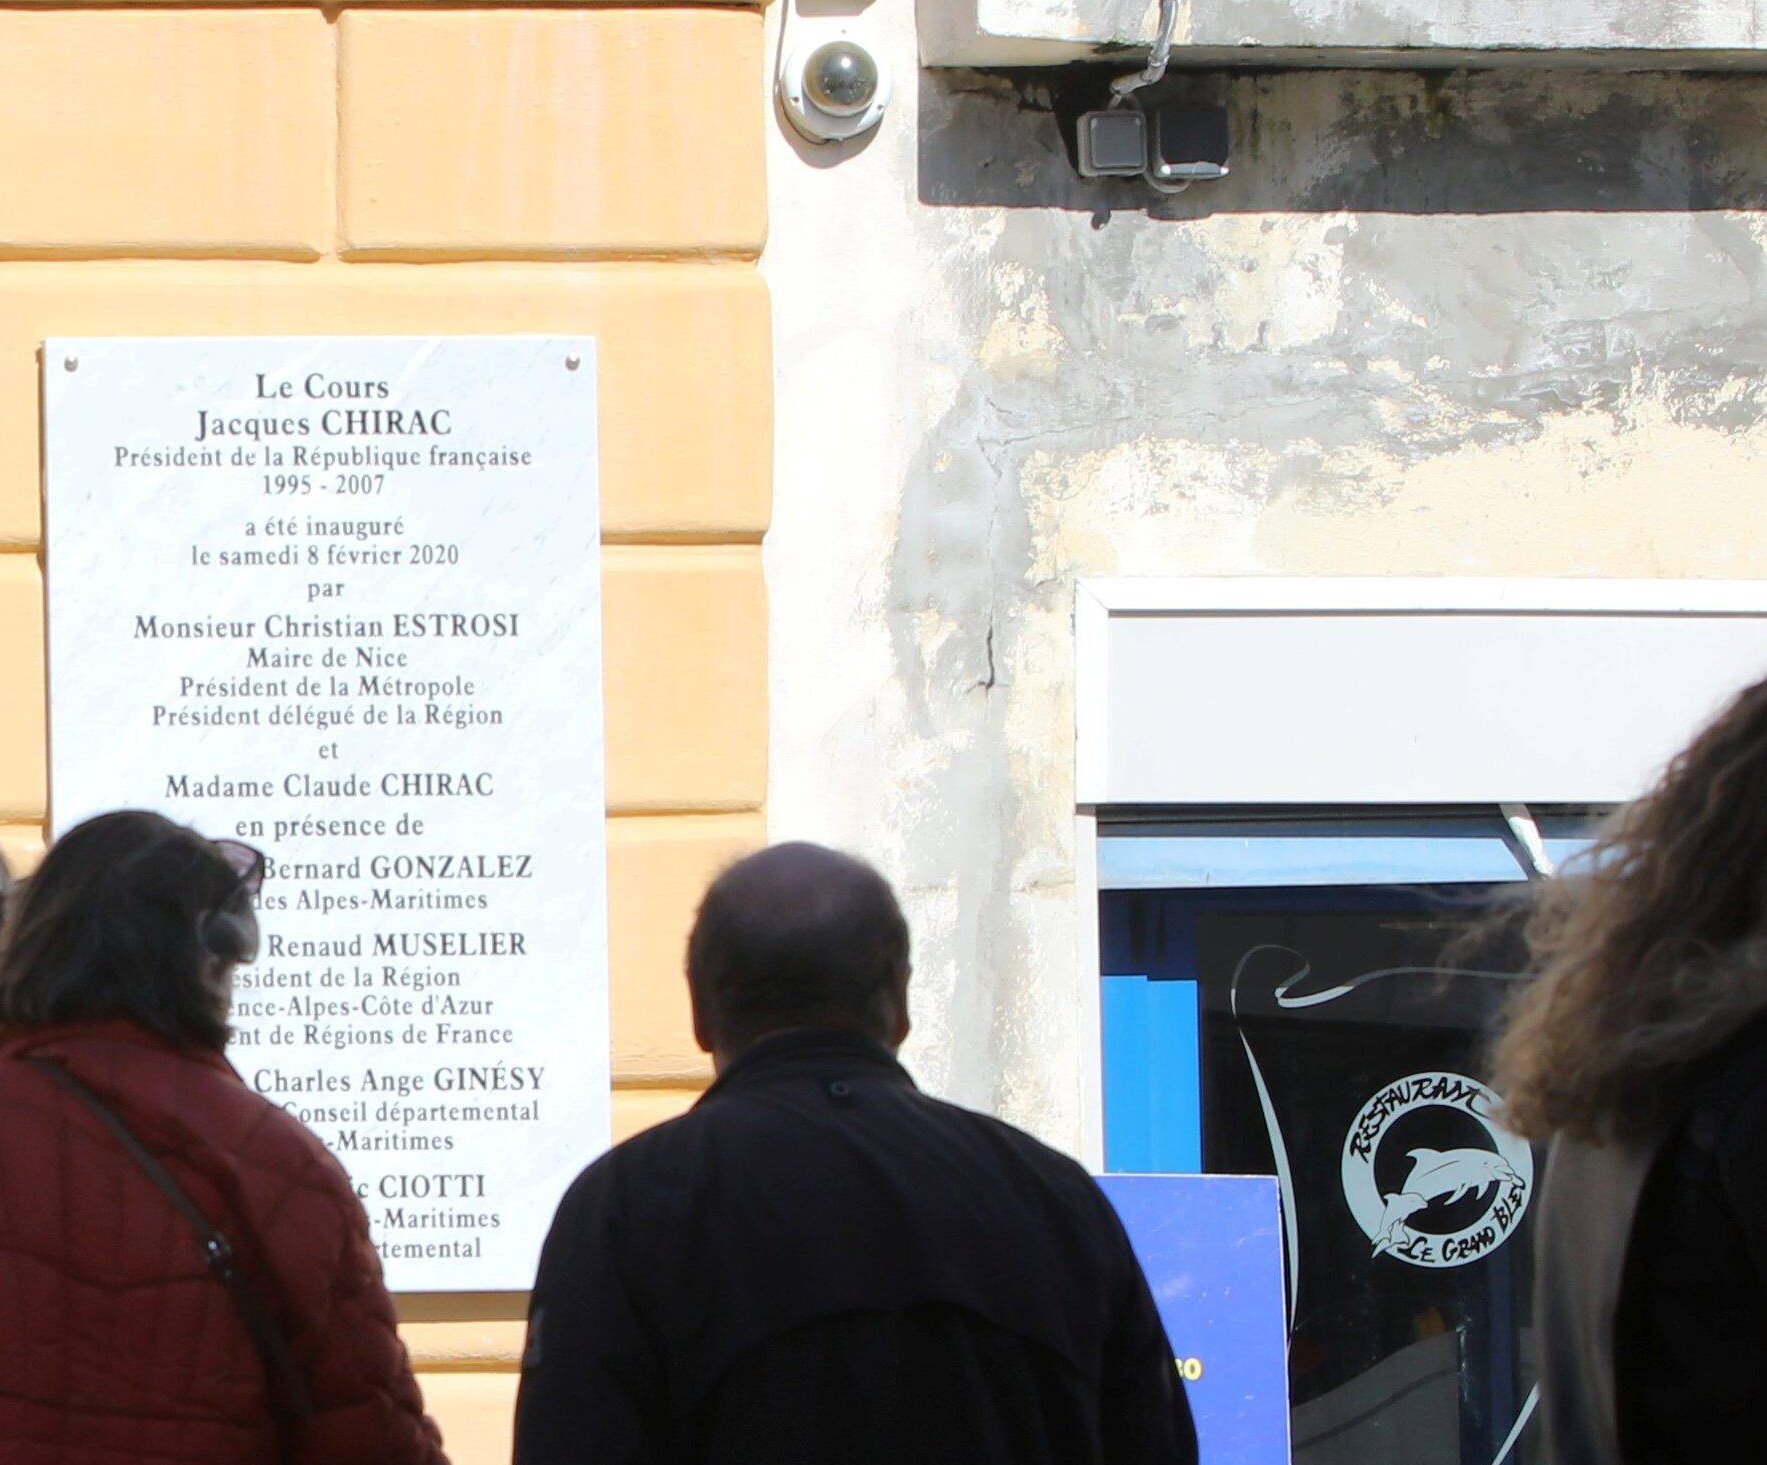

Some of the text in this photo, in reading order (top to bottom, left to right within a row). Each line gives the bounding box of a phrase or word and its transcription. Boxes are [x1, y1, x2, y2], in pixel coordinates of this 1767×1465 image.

[255, 372, 390, 400] Le Cours
[194, 409, 452, 443] Jacques CHIRAC
[114, 444, 532, 472] Président de la République française
[263, 473, 312, 495] 1995
[335, 473, 385, 495] 2007
[244, 515, 404, 541] a été inauguré
[191, 543, 459, 566] le samedi 8 février 2020
[307, 582, 345, 603] par
[133, 613, 518, 639] Monsieur Christian ESTROSI
[246, 646, 408, 669] Maire de Nice
[179, 674, 475, 702] Président de la Métropole
[152, 703, 503, 731] Président délégué de la Région
[318, 741, 339, 760] et
[165, 772, 494, 798] Madame Claude CHIRAC
[235, 812, 424, 843] en présence de
[263, 854, 533, 880] Bernard GONZALEZ
[296, 888, 488, 915] Alpes-Maritimes
[267, 932, 527, 958] Renaud MUSELIER
[234, 965, 461, 992] ésident de la Région
[227, 994, 494, 1020] nce-Alpes-Côte d'Azur
[269, 1023, 295, 1046] de
[303, 1023, 394, 1050] Régions
[401, 1022, 428, 1045] de
[435, 1022, 513, 1044] France
[253, 1060, 545, 1097] Charles Ange GINÉSY
[375, 1099, 539, 1127] départemental
[326, 1131, 454, 1152] -Maritimes
[378, 1174, 485, 1199] CIOTTI
[373, 1208, 501, 1230] -Maritimes
[375, 1238, 482, 1258] temental
[1442, 1226, 1496, 1262] GRAND
